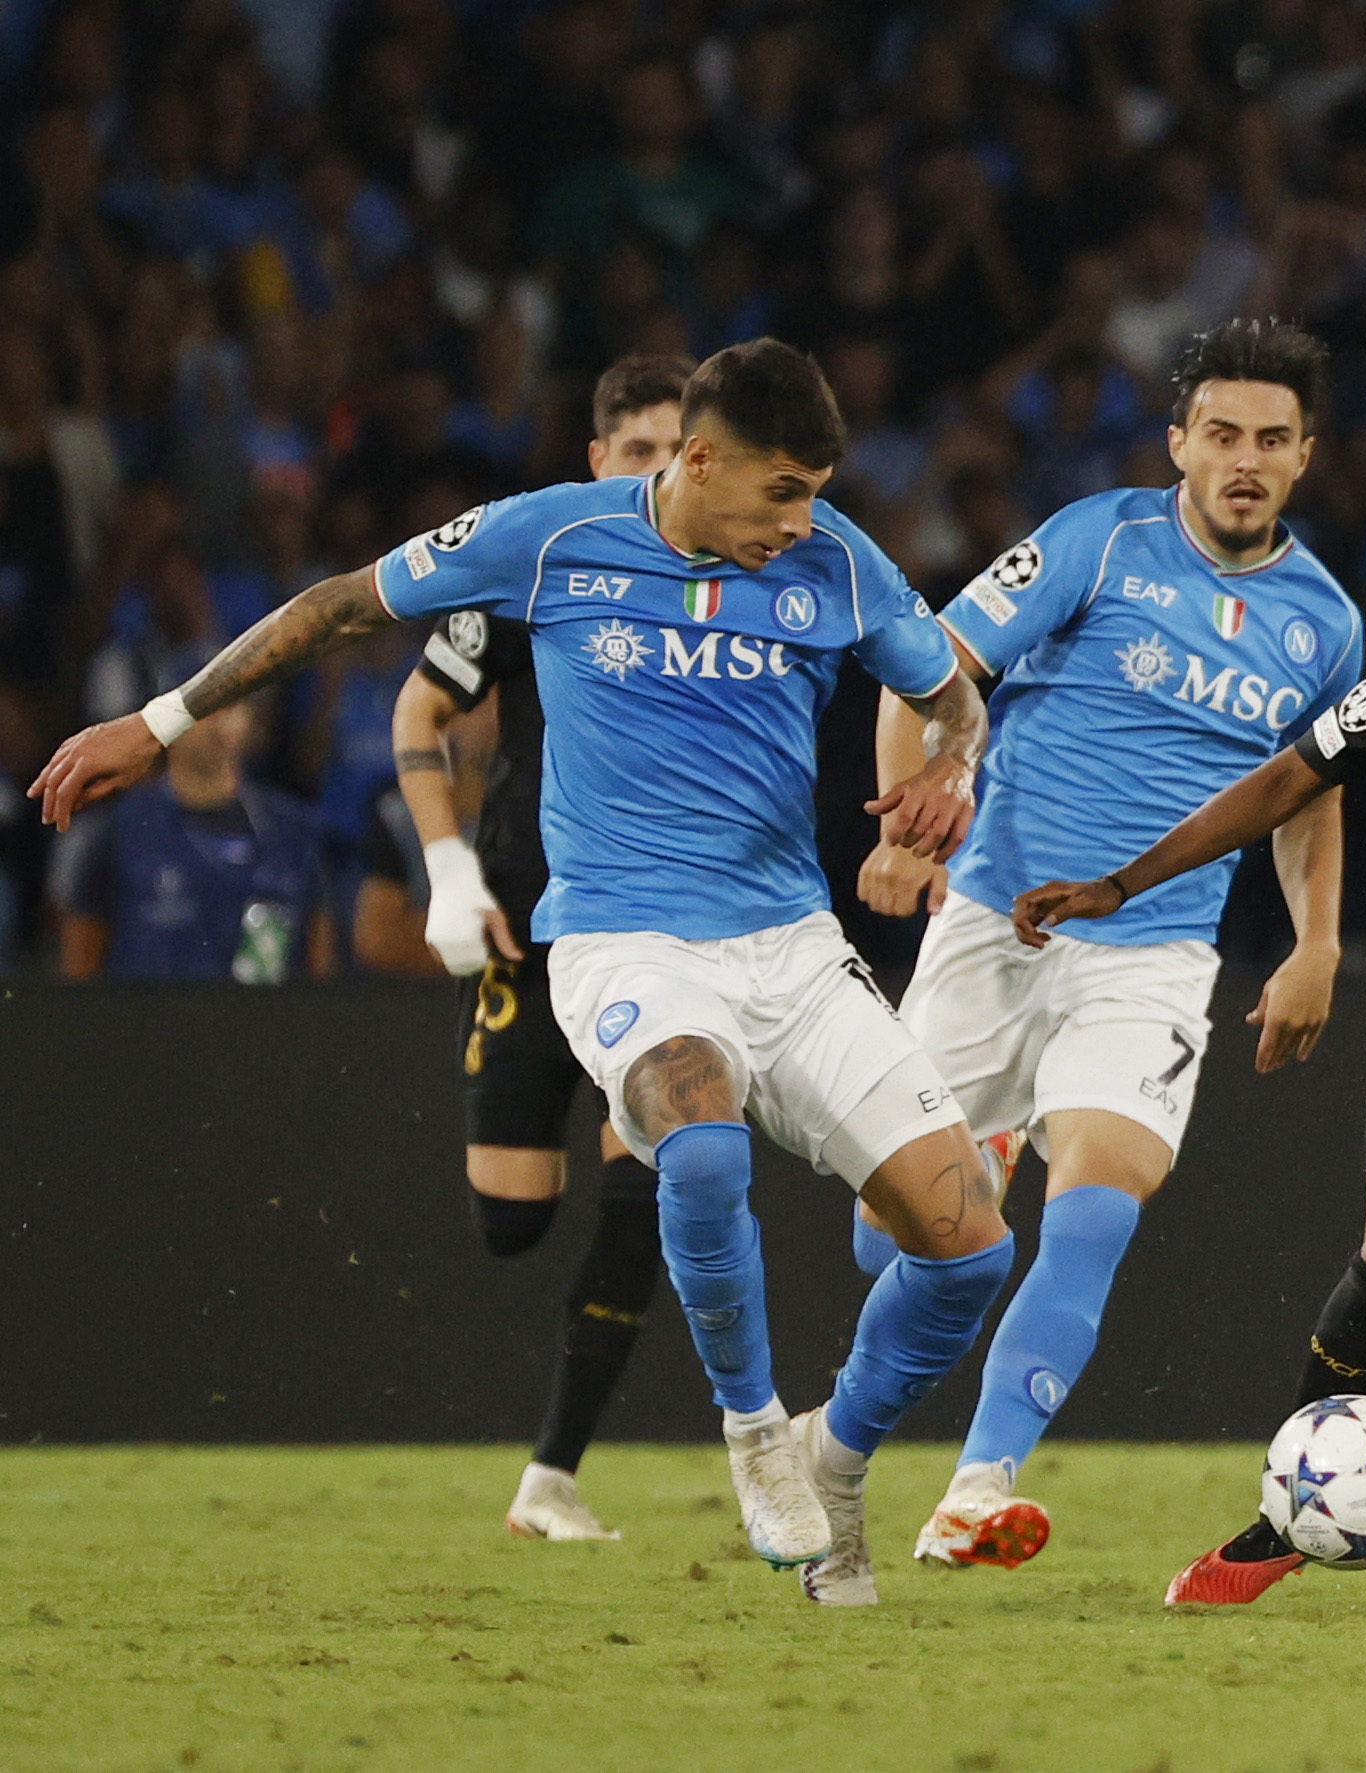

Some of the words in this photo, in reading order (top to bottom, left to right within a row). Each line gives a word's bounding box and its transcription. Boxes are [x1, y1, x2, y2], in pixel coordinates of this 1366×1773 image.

[568, 573, 633, 600] EA7
[1122, 576, 1179, 608] EA7
[784, 595, 809, 622] N
[1292, 629, 1309, 656] N
[1173, 654, 1304, 732] MSC
[1157, 1028, 1195, 1086] 7
[917, 1086, 951, 1113] EA
